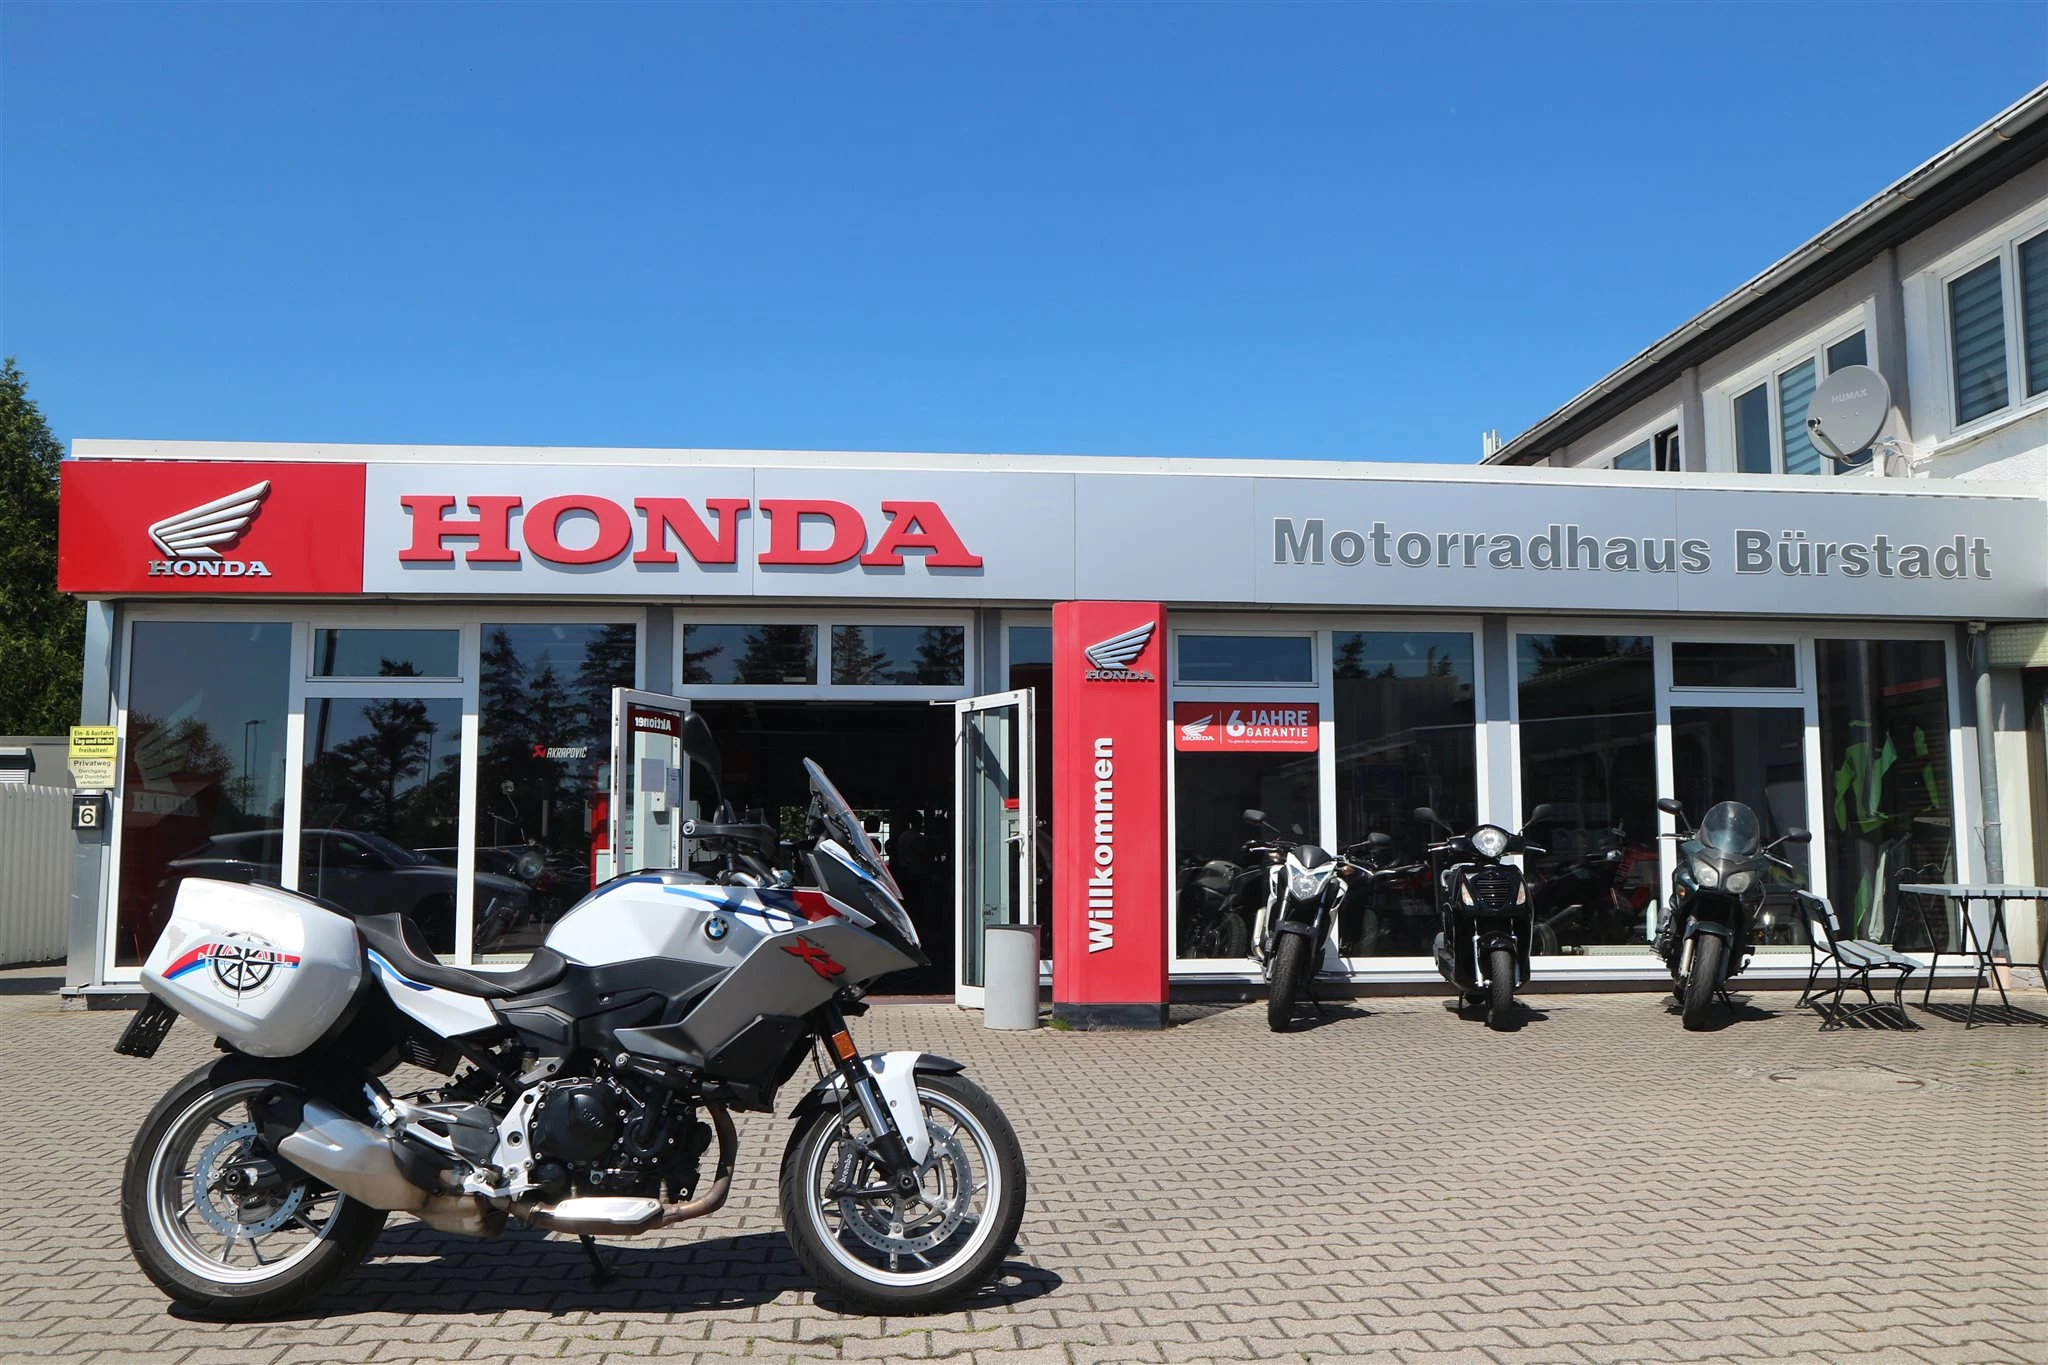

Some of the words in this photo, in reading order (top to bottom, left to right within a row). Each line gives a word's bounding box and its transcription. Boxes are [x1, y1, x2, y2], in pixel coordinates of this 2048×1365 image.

[1831, 388, 1868, 404] HUMAX
[399, 494, 983, 569] HONDA
[1273, 516, 1712, 574] Motorradhaus
[1735, 528, 1993, 581] Bürstadt
[148, 559, 272, 577] HONDA
[1085, 669, 1155, 682] HONDA
[1226, 709, 1246, 737] 6
[1246, 727, 1308, 738] GARANTIE
[80, 807, 94, 824] 6
[1088, 736, 1115, 954] Willkommen
[839, 1153, 853, 1183] brembo
